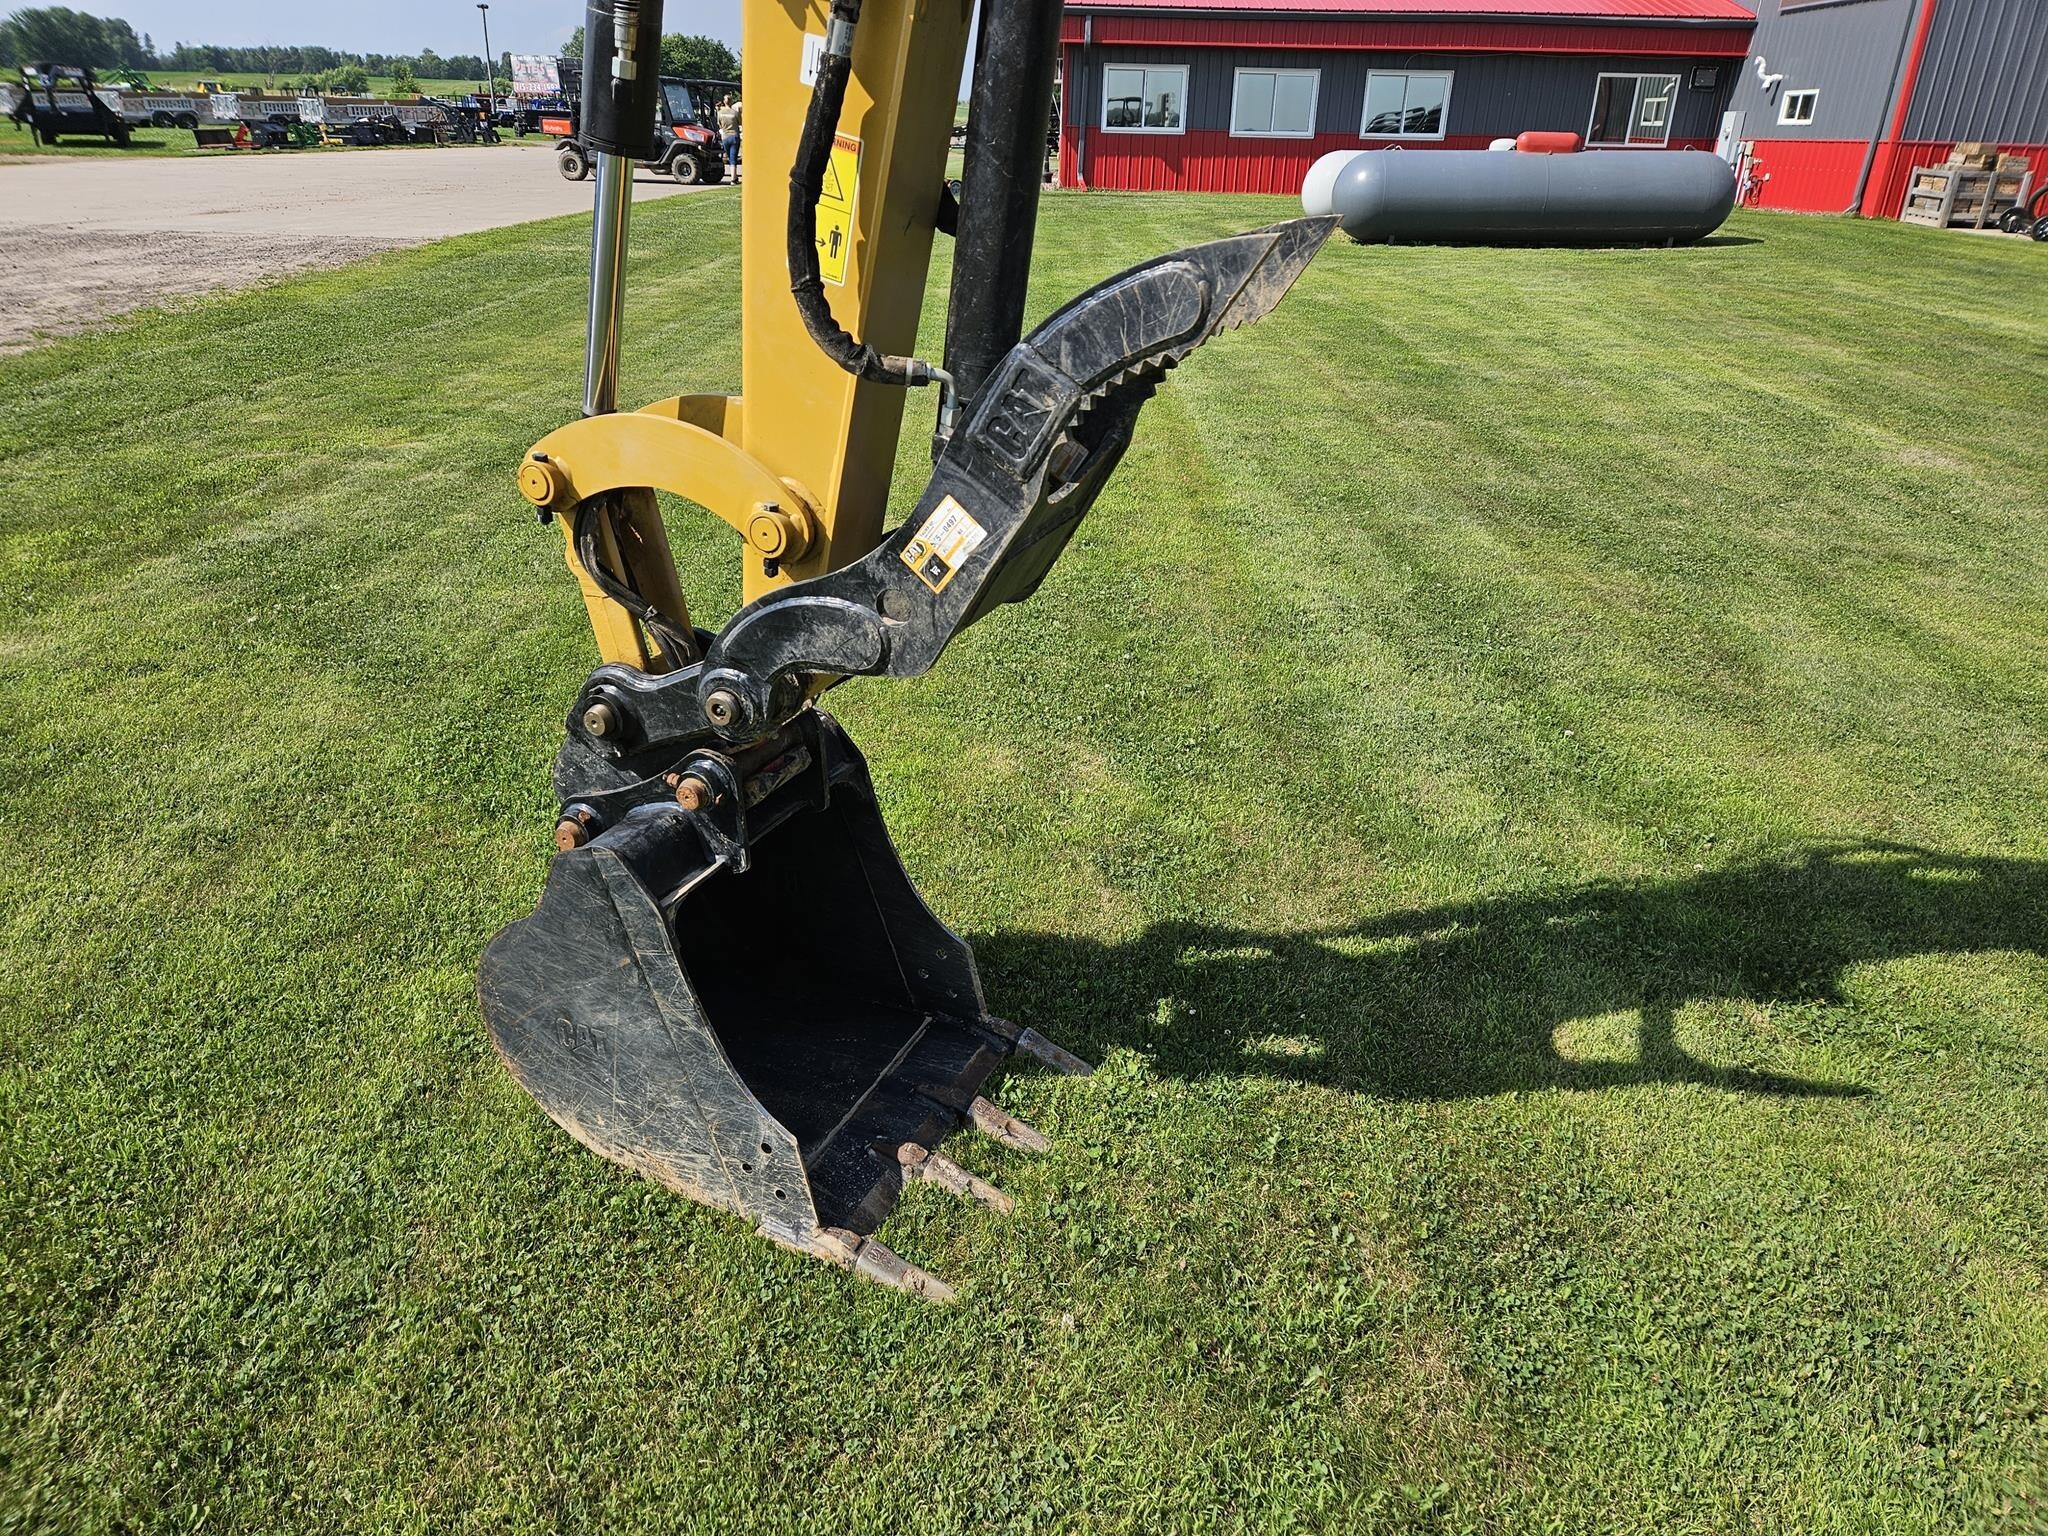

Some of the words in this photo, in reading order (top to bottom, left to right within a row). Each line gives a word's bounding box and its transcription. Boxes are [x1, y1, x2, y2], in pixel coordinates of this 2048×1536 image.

[985, 366, 1057, 460] CAT
[904, 541, 924, 564] CAT
[555, 1017, 608, 1063] CAT
